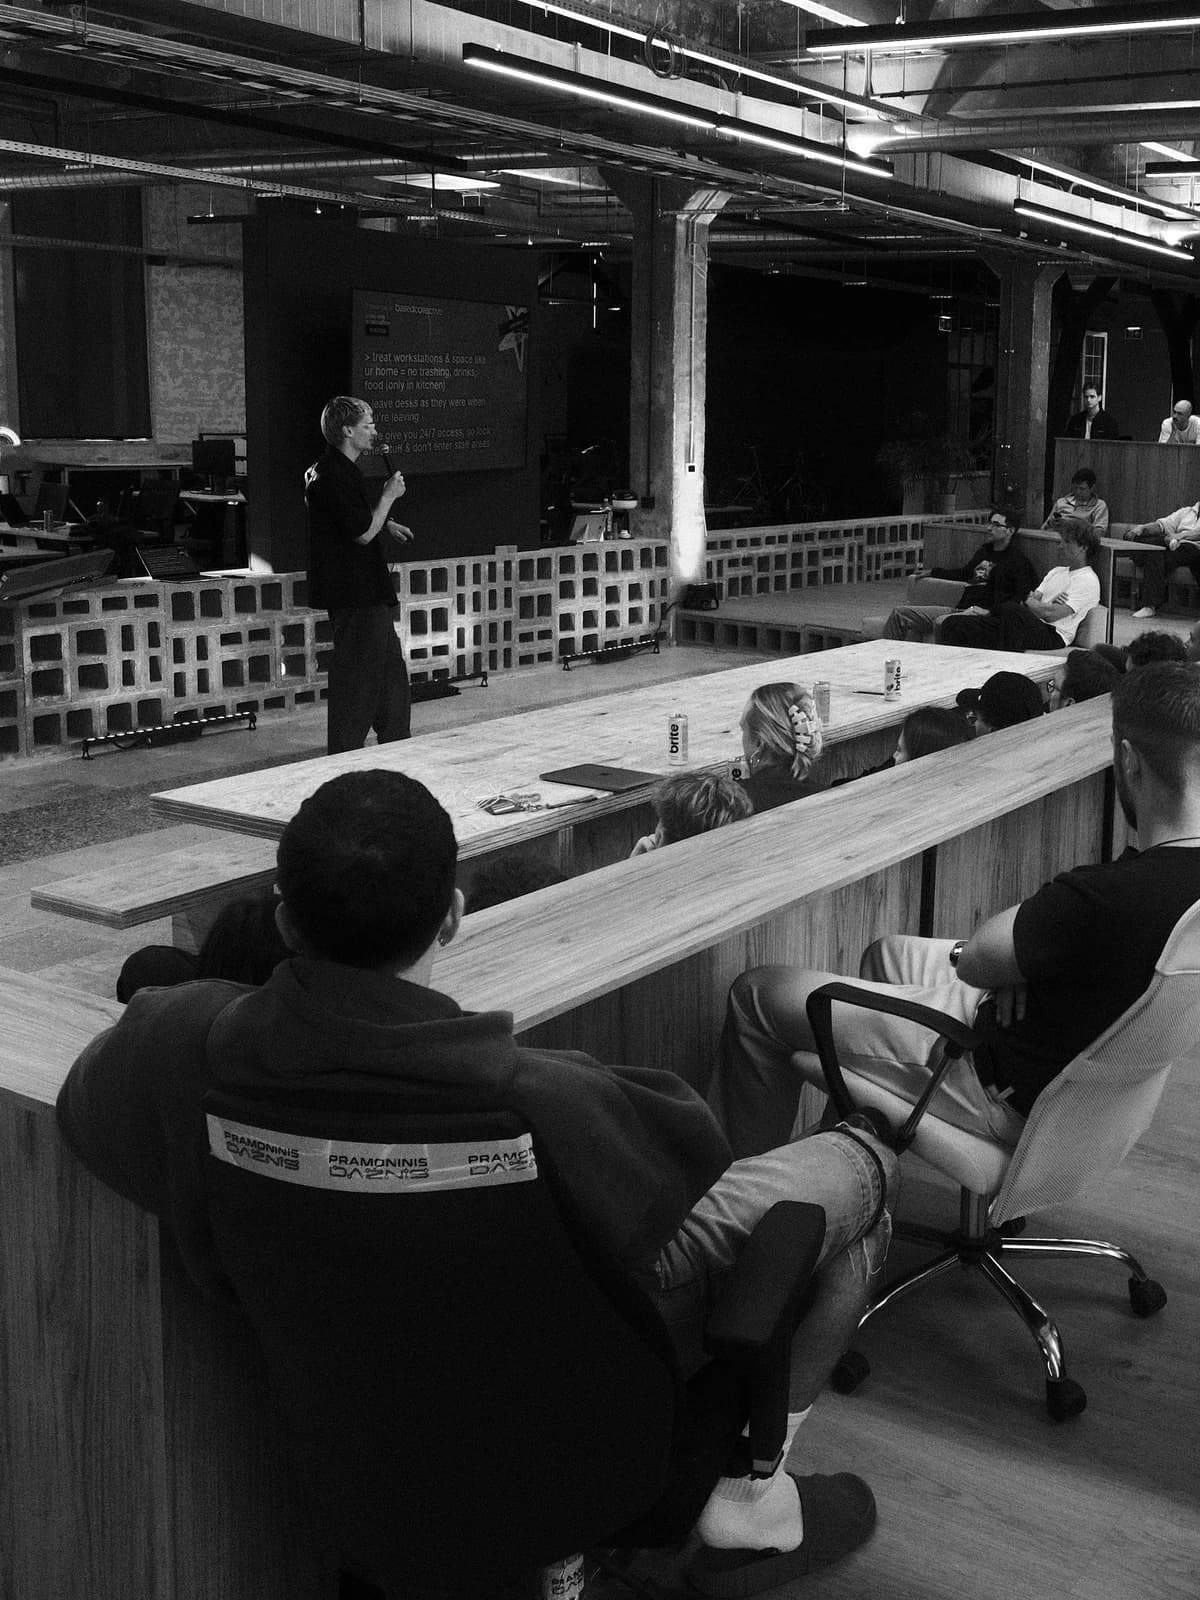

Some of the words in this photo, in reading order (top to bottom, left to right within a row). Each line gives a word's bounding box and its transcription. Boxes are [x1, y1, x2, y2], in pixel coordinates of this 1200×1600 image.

[372, 352, 391, 363] treat
[393, 352, 444, 364] workstations
[364, 368, 374, 377] ur
[376, 367, 398, 377] home
[407, 367, 417, 377] no
[364, 380, 384, 391] food
[371, 397, 393, 409] leave
[395, 397, 418, 409] desks
[420, 398, 429, 408] as
[430, 397, 447, 410] they
[448, 397, 466, 408] were
[402, 430, 417, 443] you
[668, 723, 679, 754] brite
[224, 1131, 299, 1158] PRAMONINIS
[329, 1154, 428, 1168] PRAMONINIS
